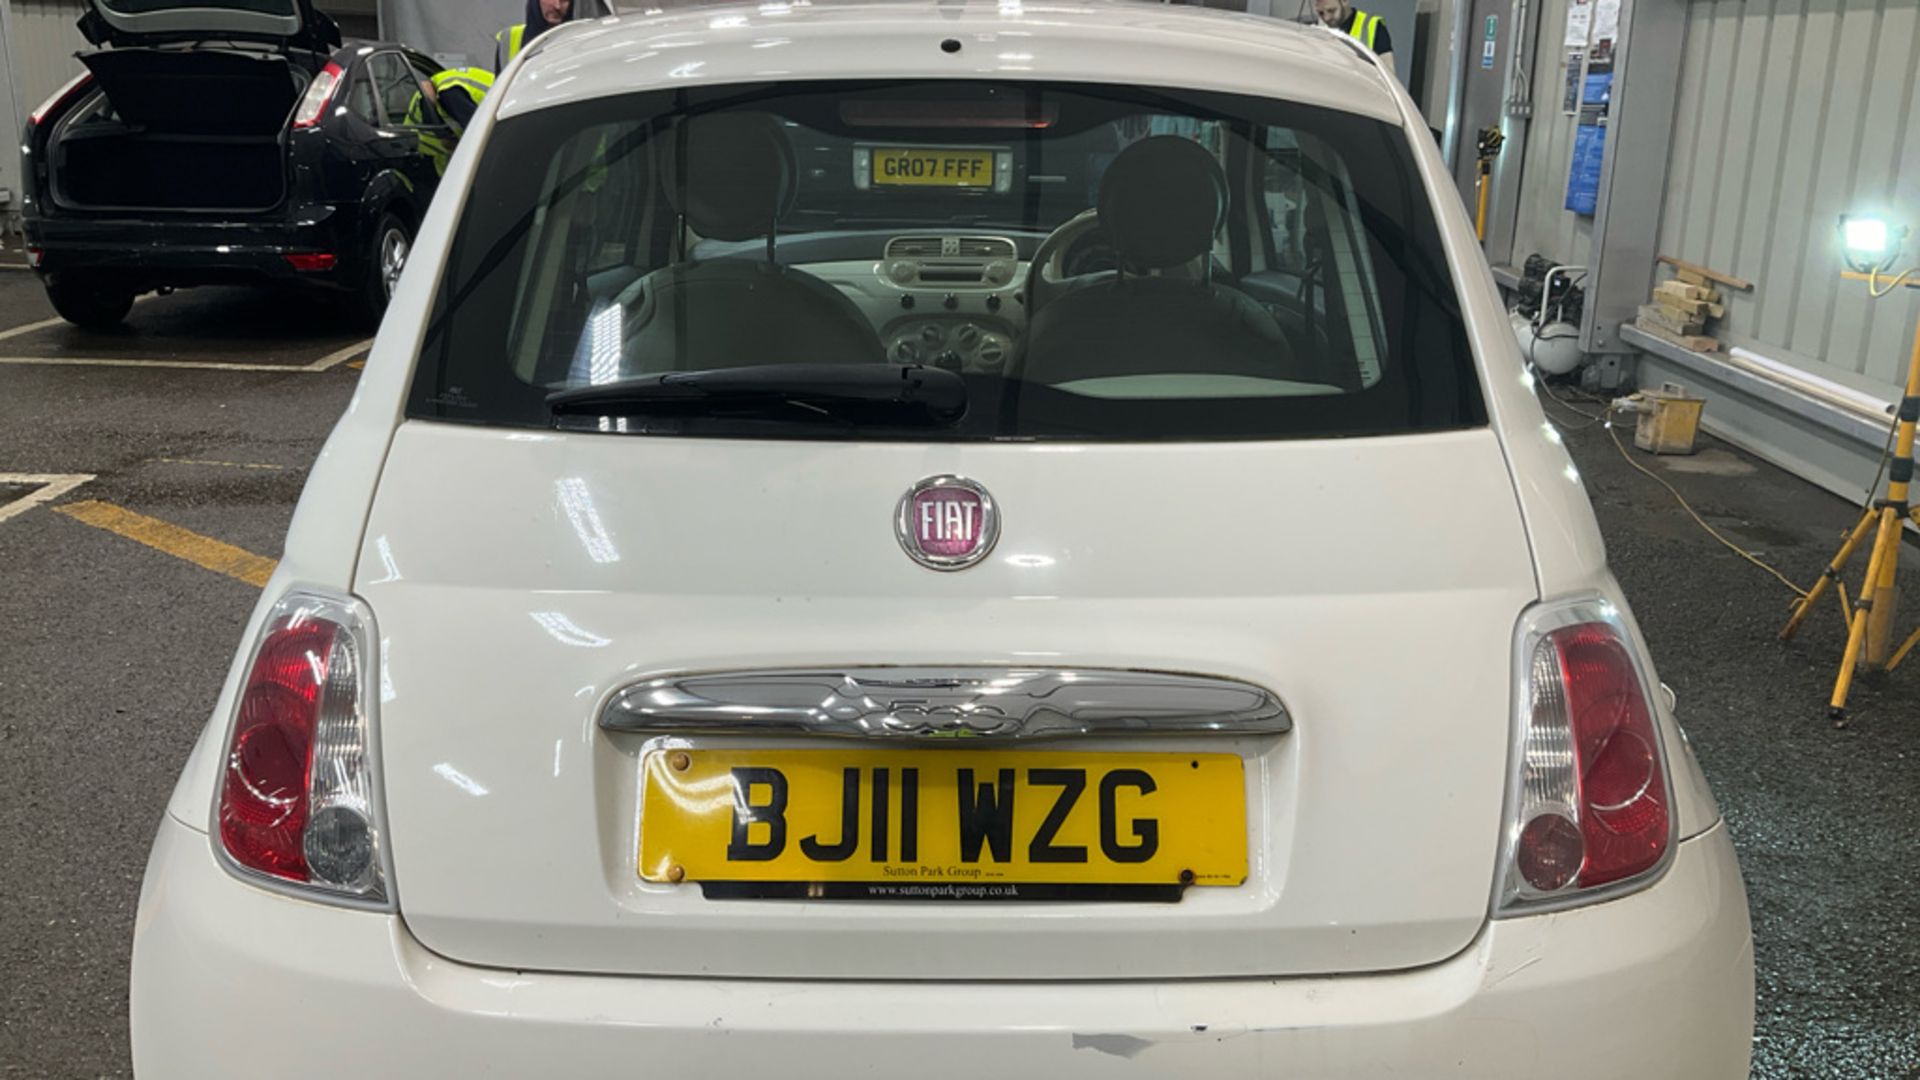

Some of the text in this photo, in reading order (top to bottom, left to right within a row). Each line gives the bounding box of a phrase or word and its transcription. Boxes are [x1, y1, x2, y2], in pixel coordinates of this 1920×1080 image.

[884, 158, 984, 177] GR07 FFF
[922, 501, 977, 540] FIAT
[727, 767, 1159, 863] BJ11 WZG
[883, 866, 918, 876] Sutton
[921, 866, 944, 876] Park
[947, 866, 981, 879] Group
[868, 884, 1019, 898] www.suttonparkgroup.co.uk
